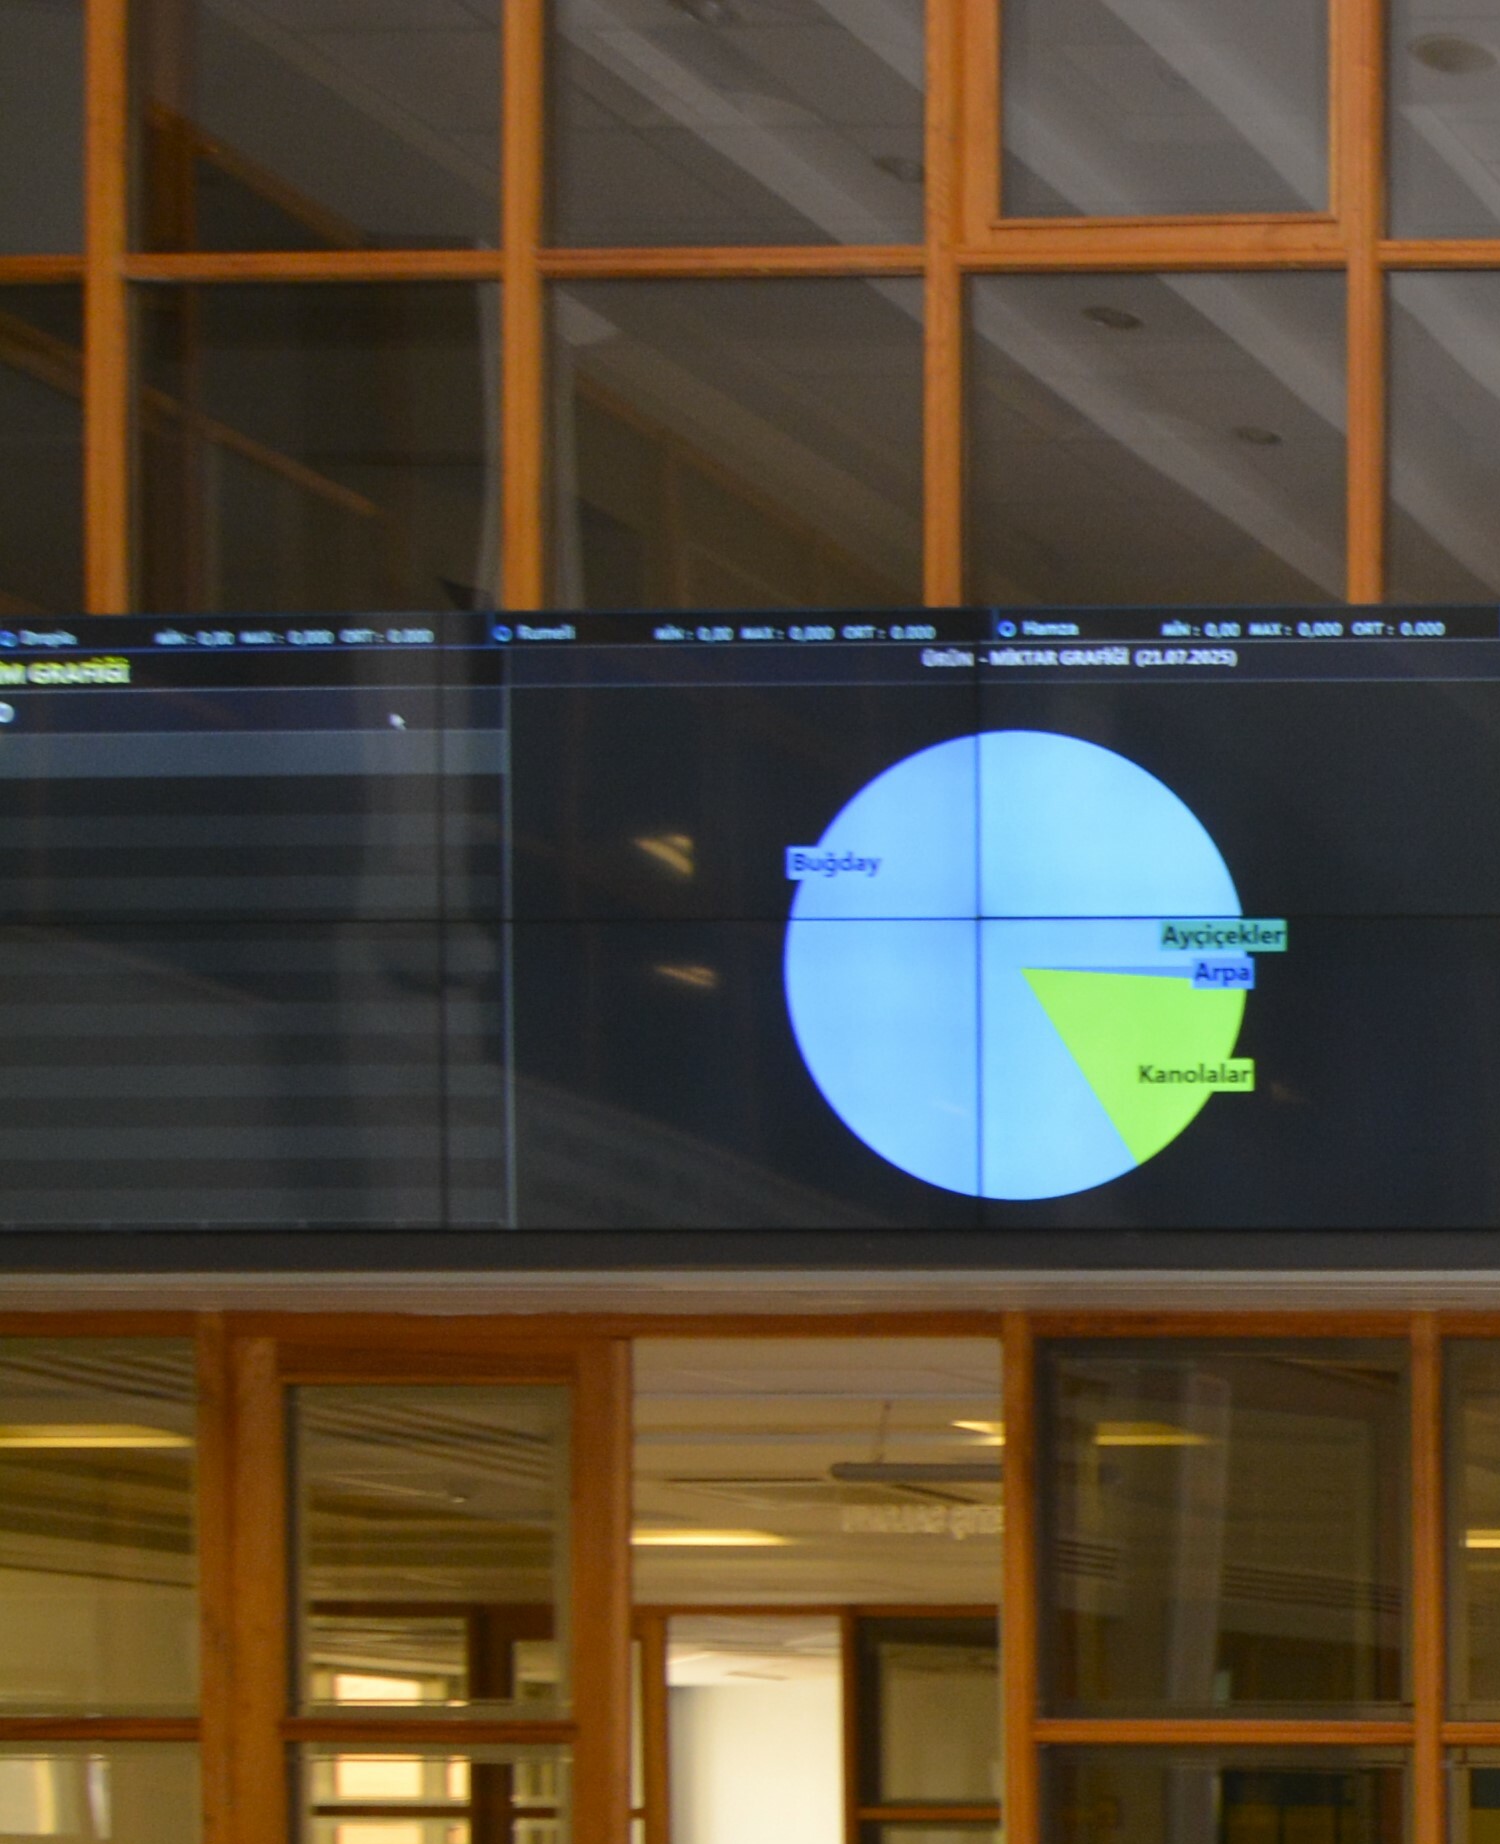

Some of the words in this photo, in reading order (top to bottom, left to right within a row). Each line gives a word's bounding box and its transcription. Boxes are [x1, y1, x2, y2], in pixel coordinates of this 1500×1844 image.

[791, 852, 881, 878] Buğday
[1162, 925, 1286, 951] Ayçiçekler
[1194, 962, 1251, 986] Arpa
[1138, 1064, 1252, 1085] Kanolalar
